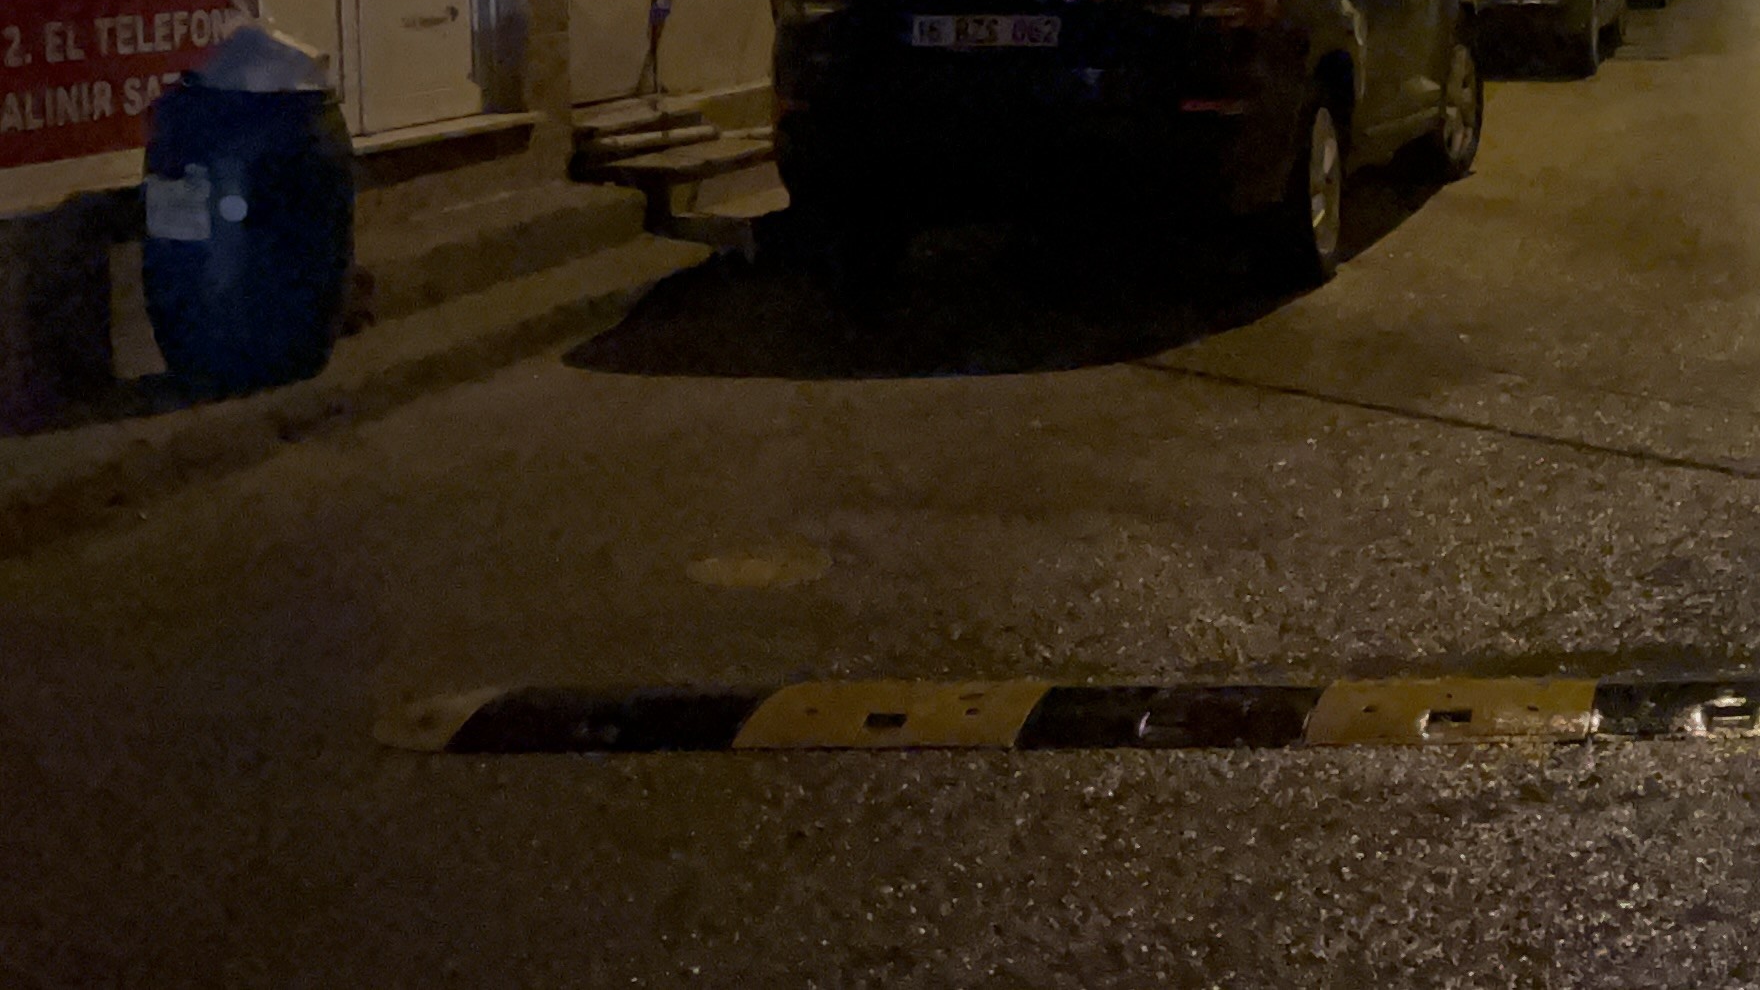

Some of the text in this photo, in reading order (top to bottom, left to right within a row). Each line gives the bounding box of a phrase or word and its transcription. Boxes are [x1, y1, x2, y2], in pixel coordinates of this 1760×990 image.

[3, 24, 32, 68] 2.
[45, 21, 85, 63] EL
[0, 80, 114, 132] ALINIR
